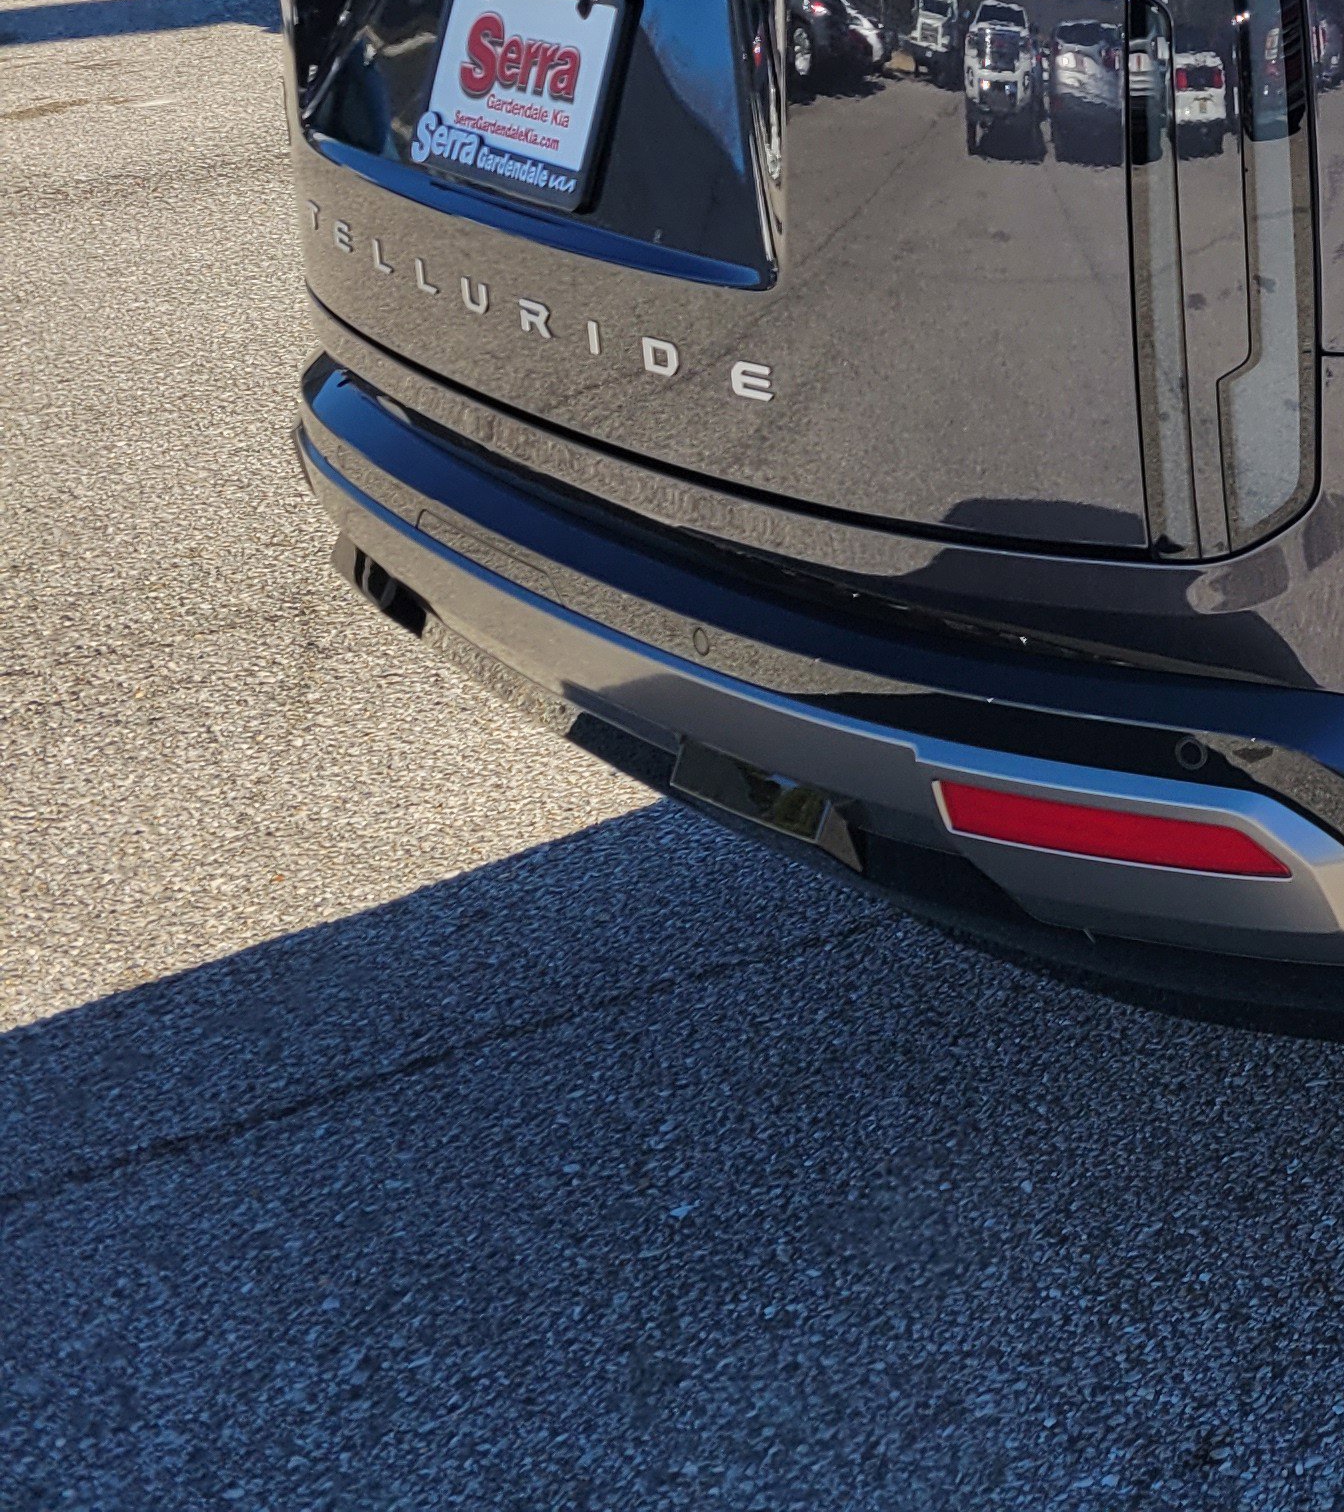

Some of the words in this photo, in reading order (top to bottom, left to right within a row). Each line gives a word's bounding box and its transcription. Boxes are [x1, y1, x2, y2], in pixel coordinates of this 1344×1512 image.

[459, 11, 582, 104] Serra
[454, 110, 560, 151] SerraGardendaleKia.com
[486, 93, 549, 124] Gardendale
[551, 110, 571, 128] Kia
[411, 111, 481, 166] Serra
[477, 147, 549, 187] Gardendale
[307, 199, 776, 402] TELLURIDE
